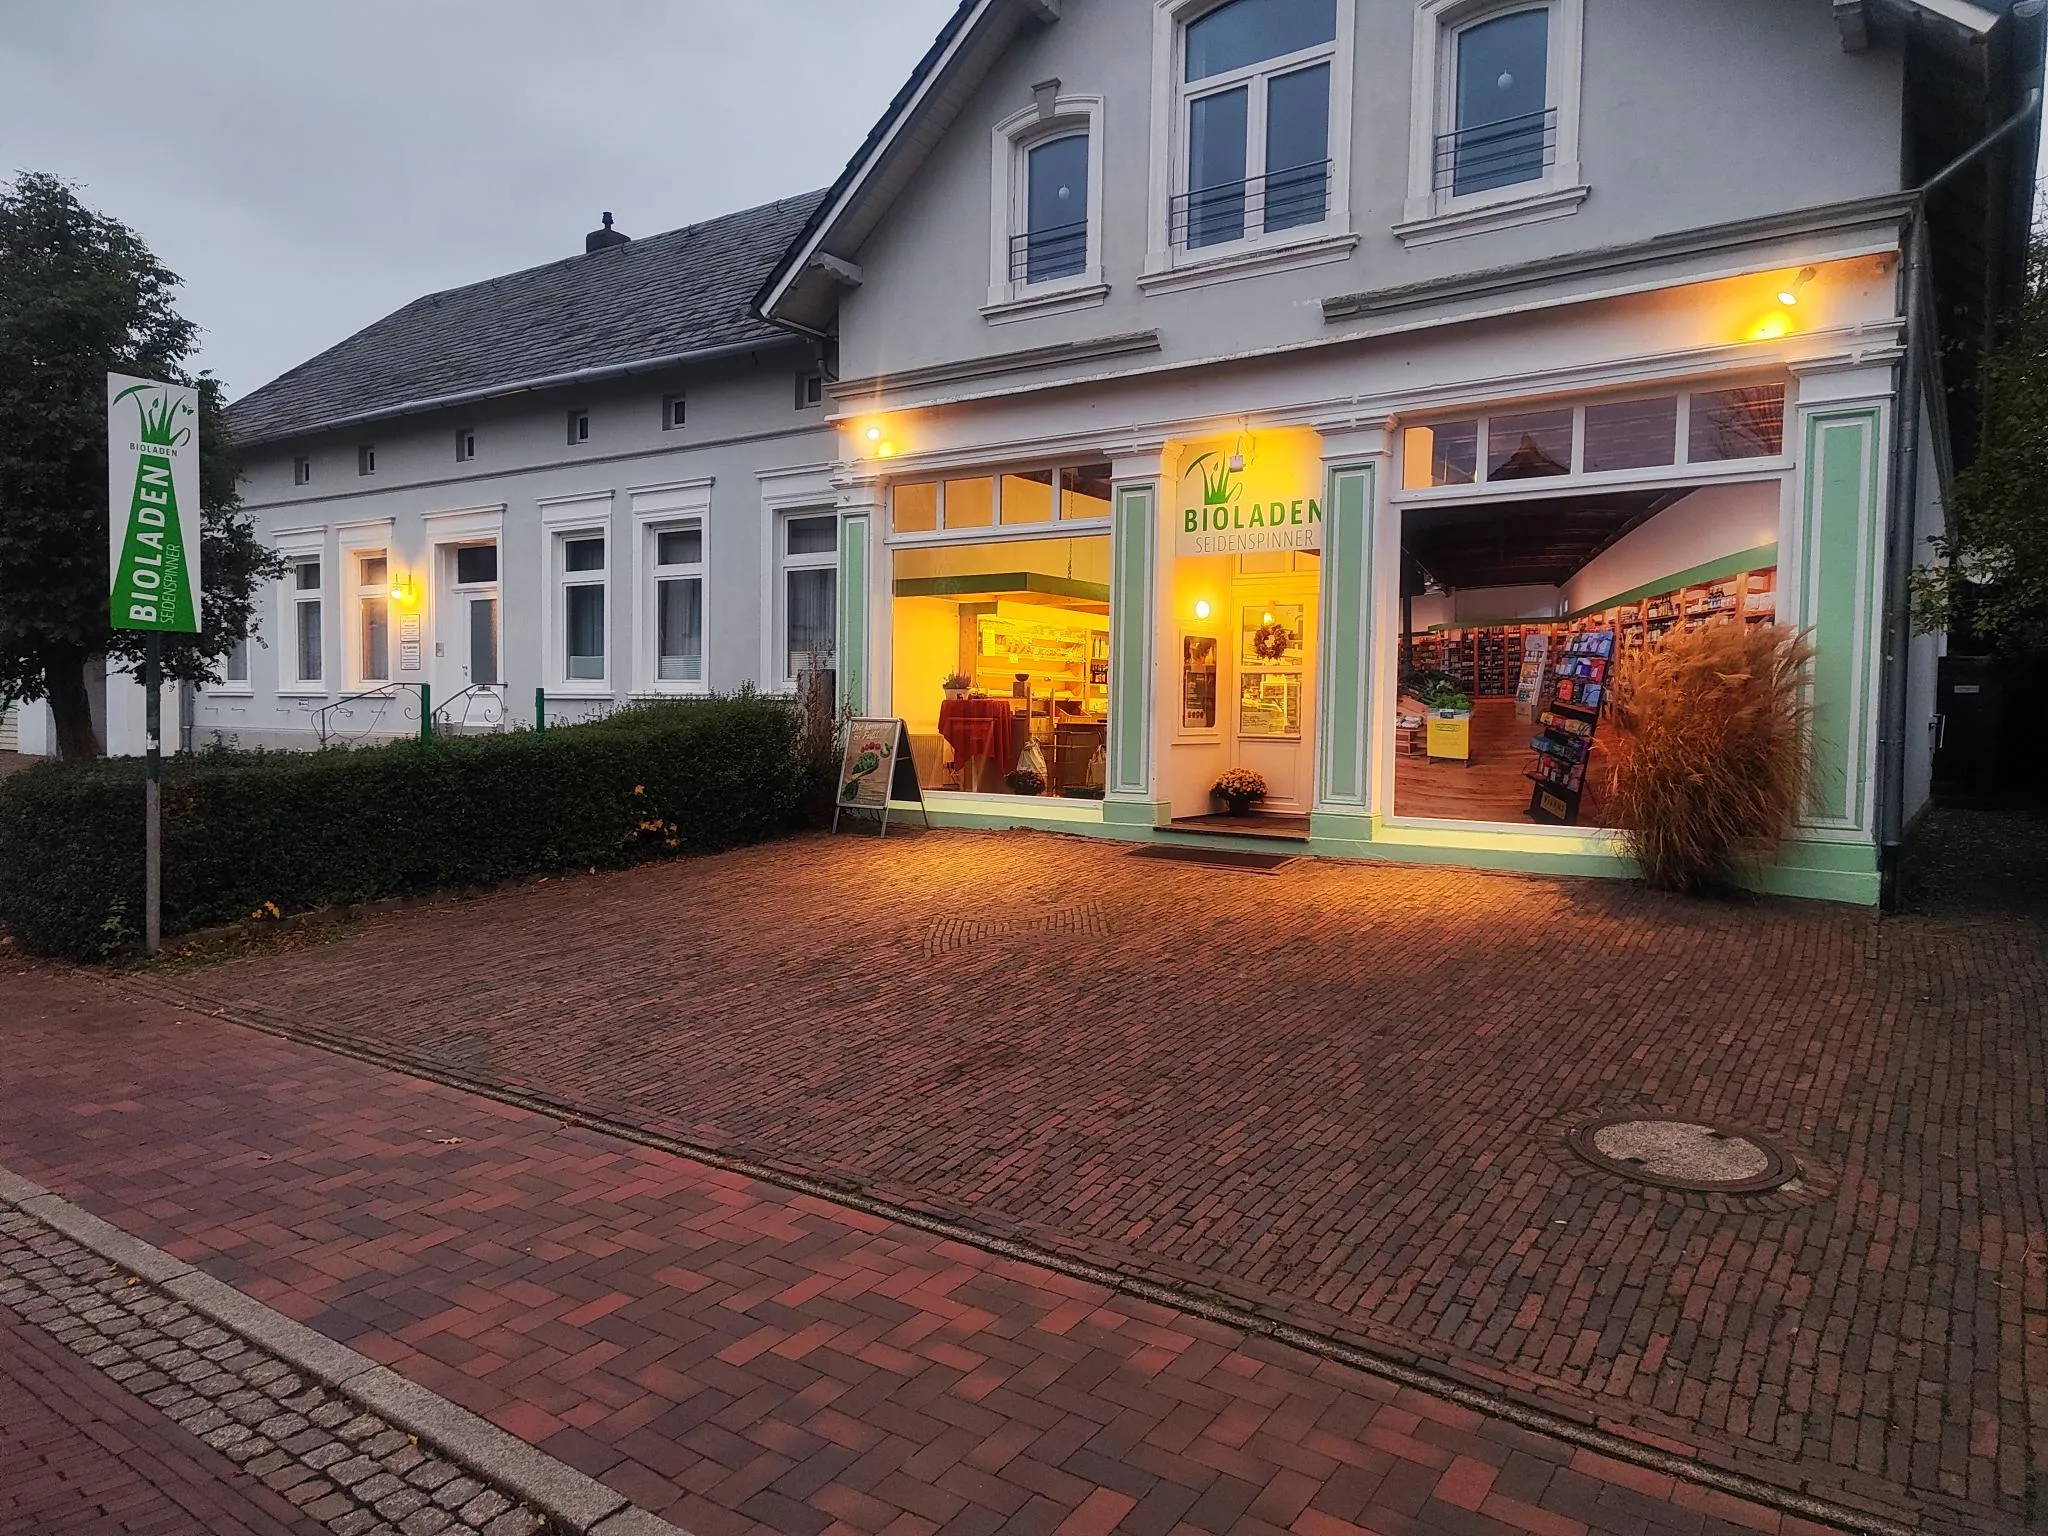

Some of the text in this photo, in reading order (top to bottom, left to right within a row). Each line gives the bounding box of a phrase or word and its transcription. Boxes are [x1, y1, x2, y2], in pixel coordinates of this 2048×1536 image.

[129, 442, 178, 457] BIOLADEN
[1184, 499, 1322, 533] BIOLADEN
[129, 464, 170, 622] BIOLADEN
[1195, 529, 1314, 553] SEIDENSPINNER
[160, 543, 181, 624] SEIDENSPINNER
